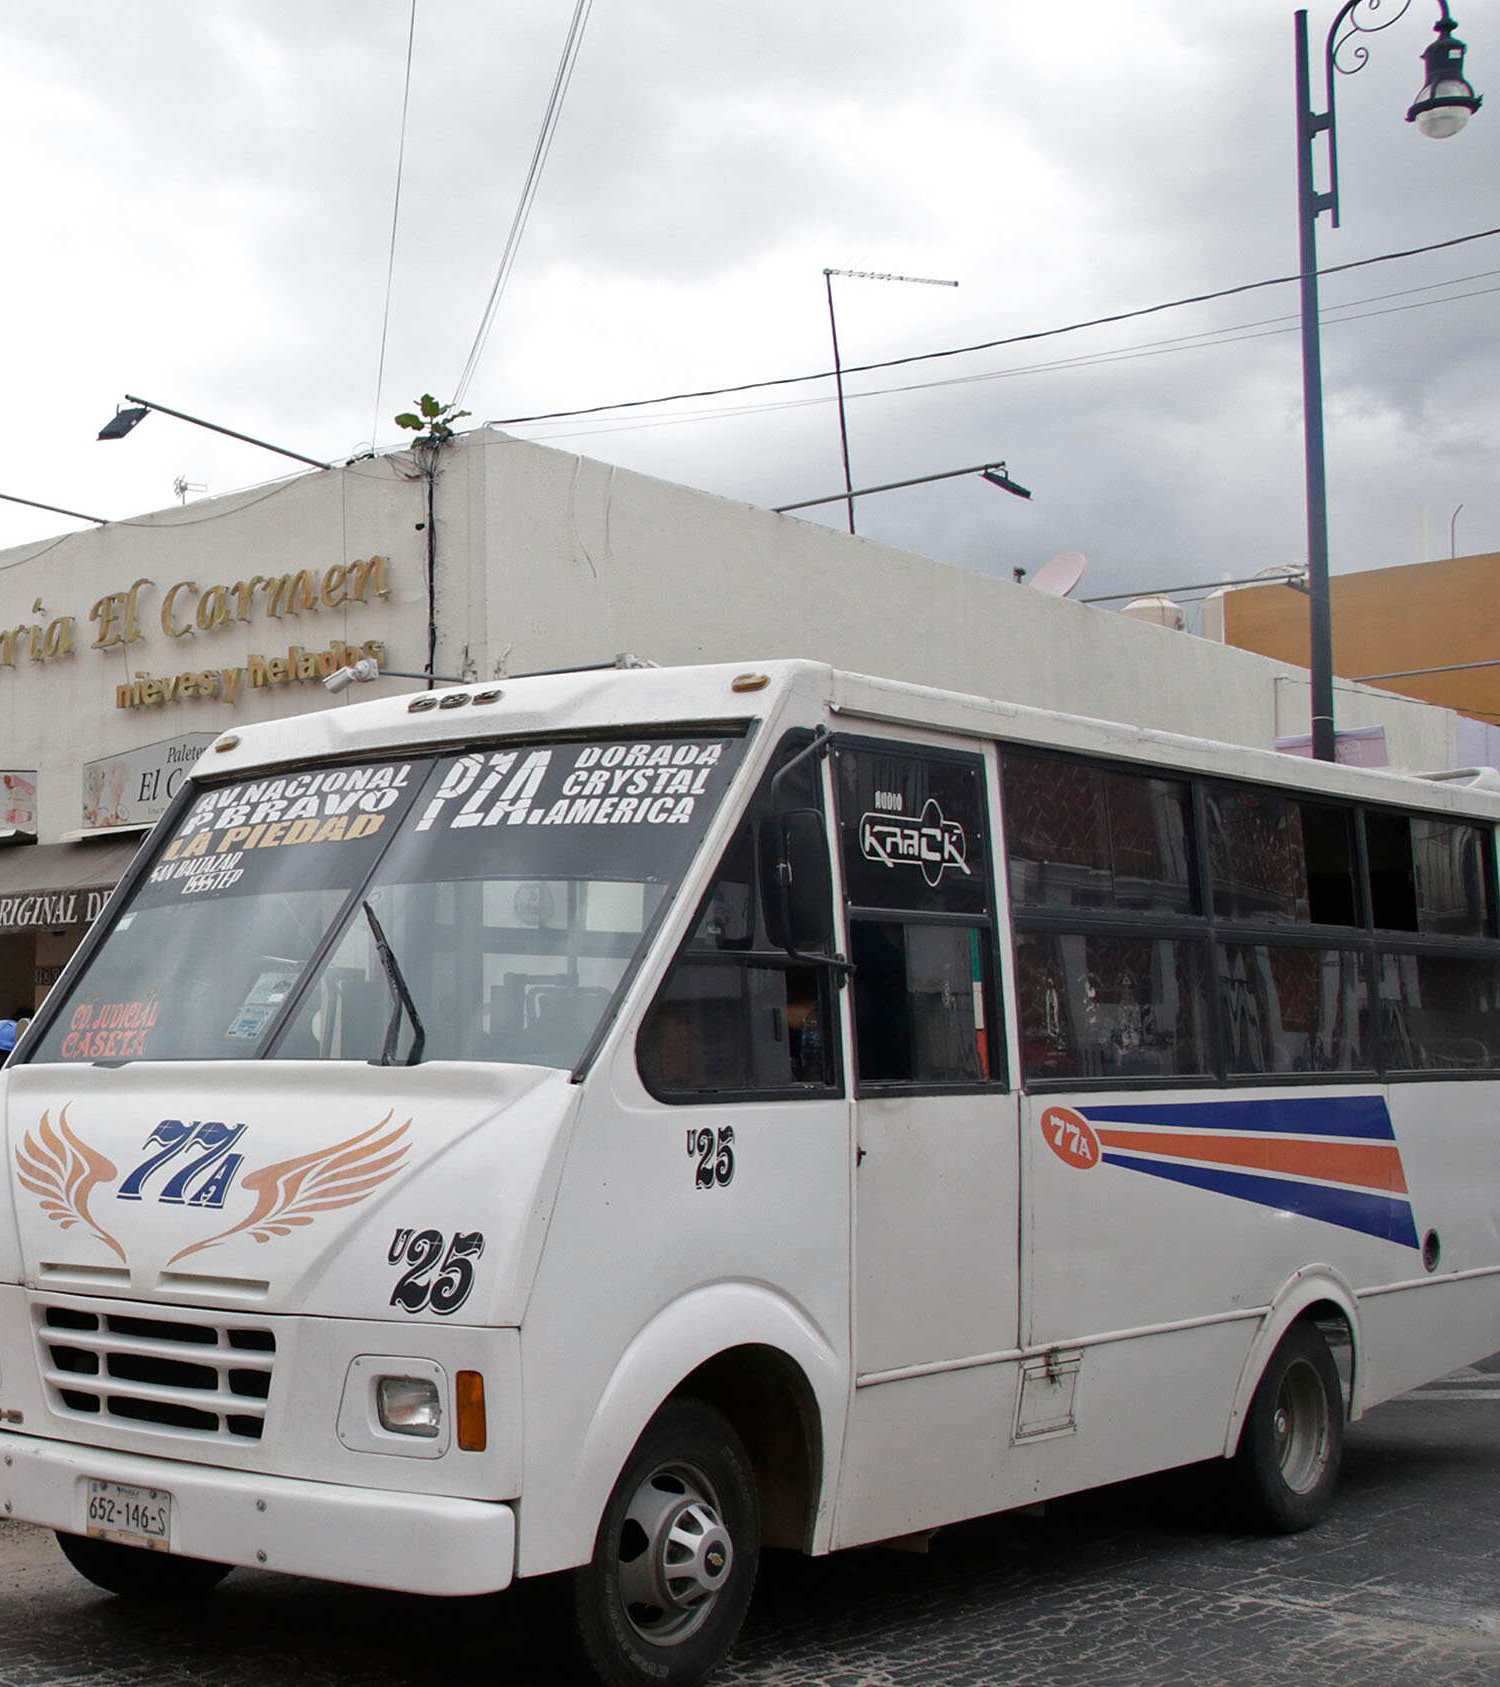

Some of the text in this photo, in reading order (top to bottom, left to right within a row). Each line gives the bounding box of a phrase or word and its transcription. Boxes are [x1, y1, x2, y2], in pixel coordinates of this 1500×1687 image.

[89, 578, 154, 651] El
[161, 555, 393, 639] Carmen
[116, 671, 219, 709] nieves
[220, 667, 244, 704] y
[167, 743, 207, 764] Palete
[574, 743, 723, 768] DORADA
[138, 768, 161, 802] El
[562, 767, 710, 797] CRYSTAL
[543, 797, 696, 825] AMERICA
[875, 791, 903, 812] AUDIO
[163, 814, 386, 862] LA PIEDAD
[173, 852, 244, 880] BALTAZAR
[1050, 1114, 1093, 1161] 77A
[116, 1119, 248, 1209] 77A
